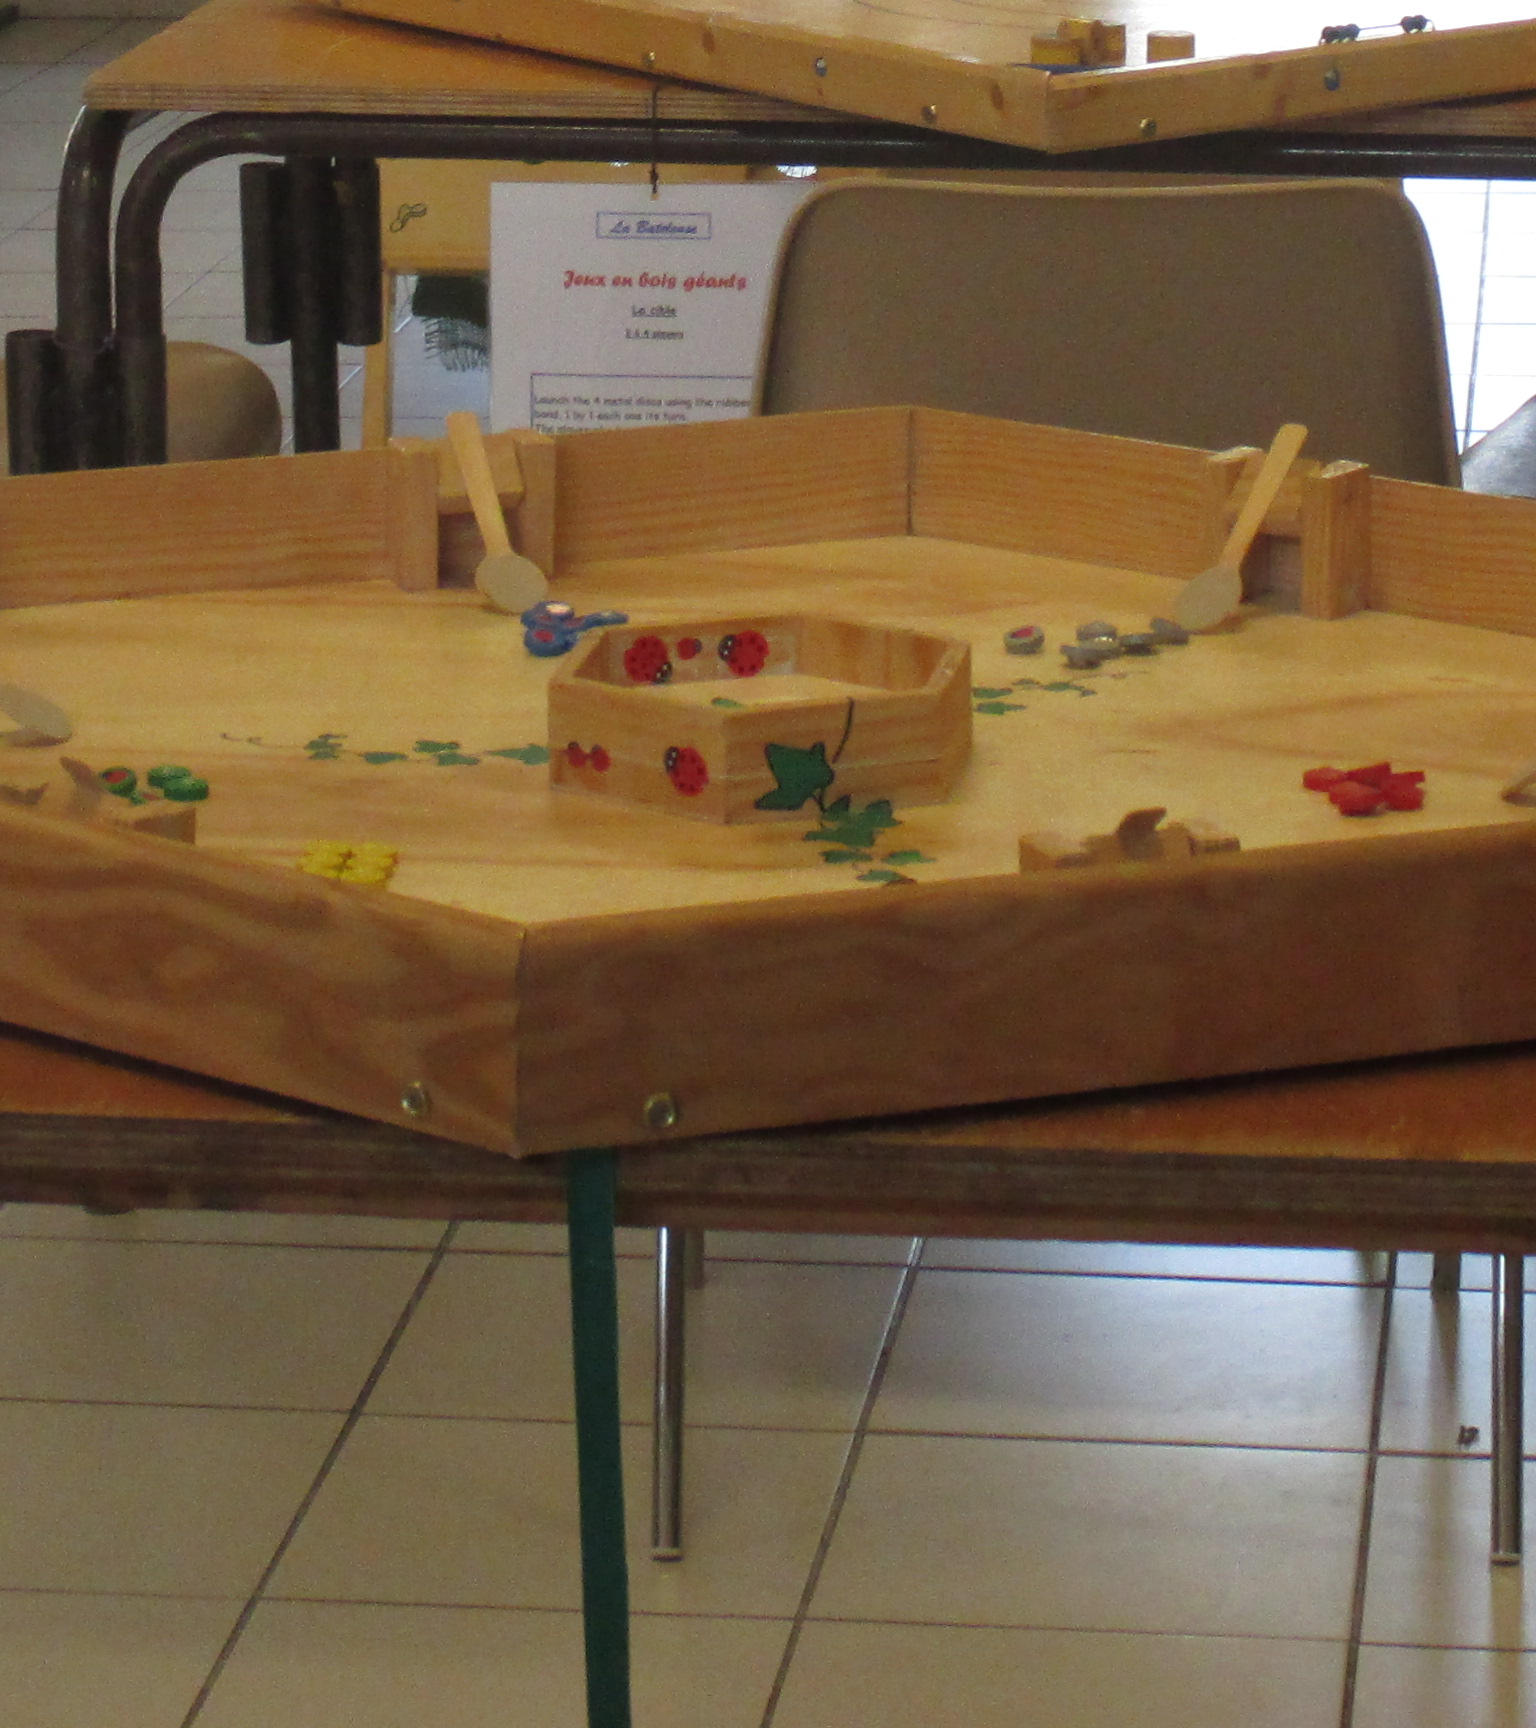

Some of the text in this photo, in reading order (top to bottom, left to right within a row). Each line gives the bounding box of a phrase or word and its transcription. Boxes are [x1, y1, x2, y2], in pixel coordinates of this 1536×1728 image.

[564, 270, 748, 292] Jeux en bois géants
[573, 396, 590, 405] the
[695, 398, 713, 407] the
